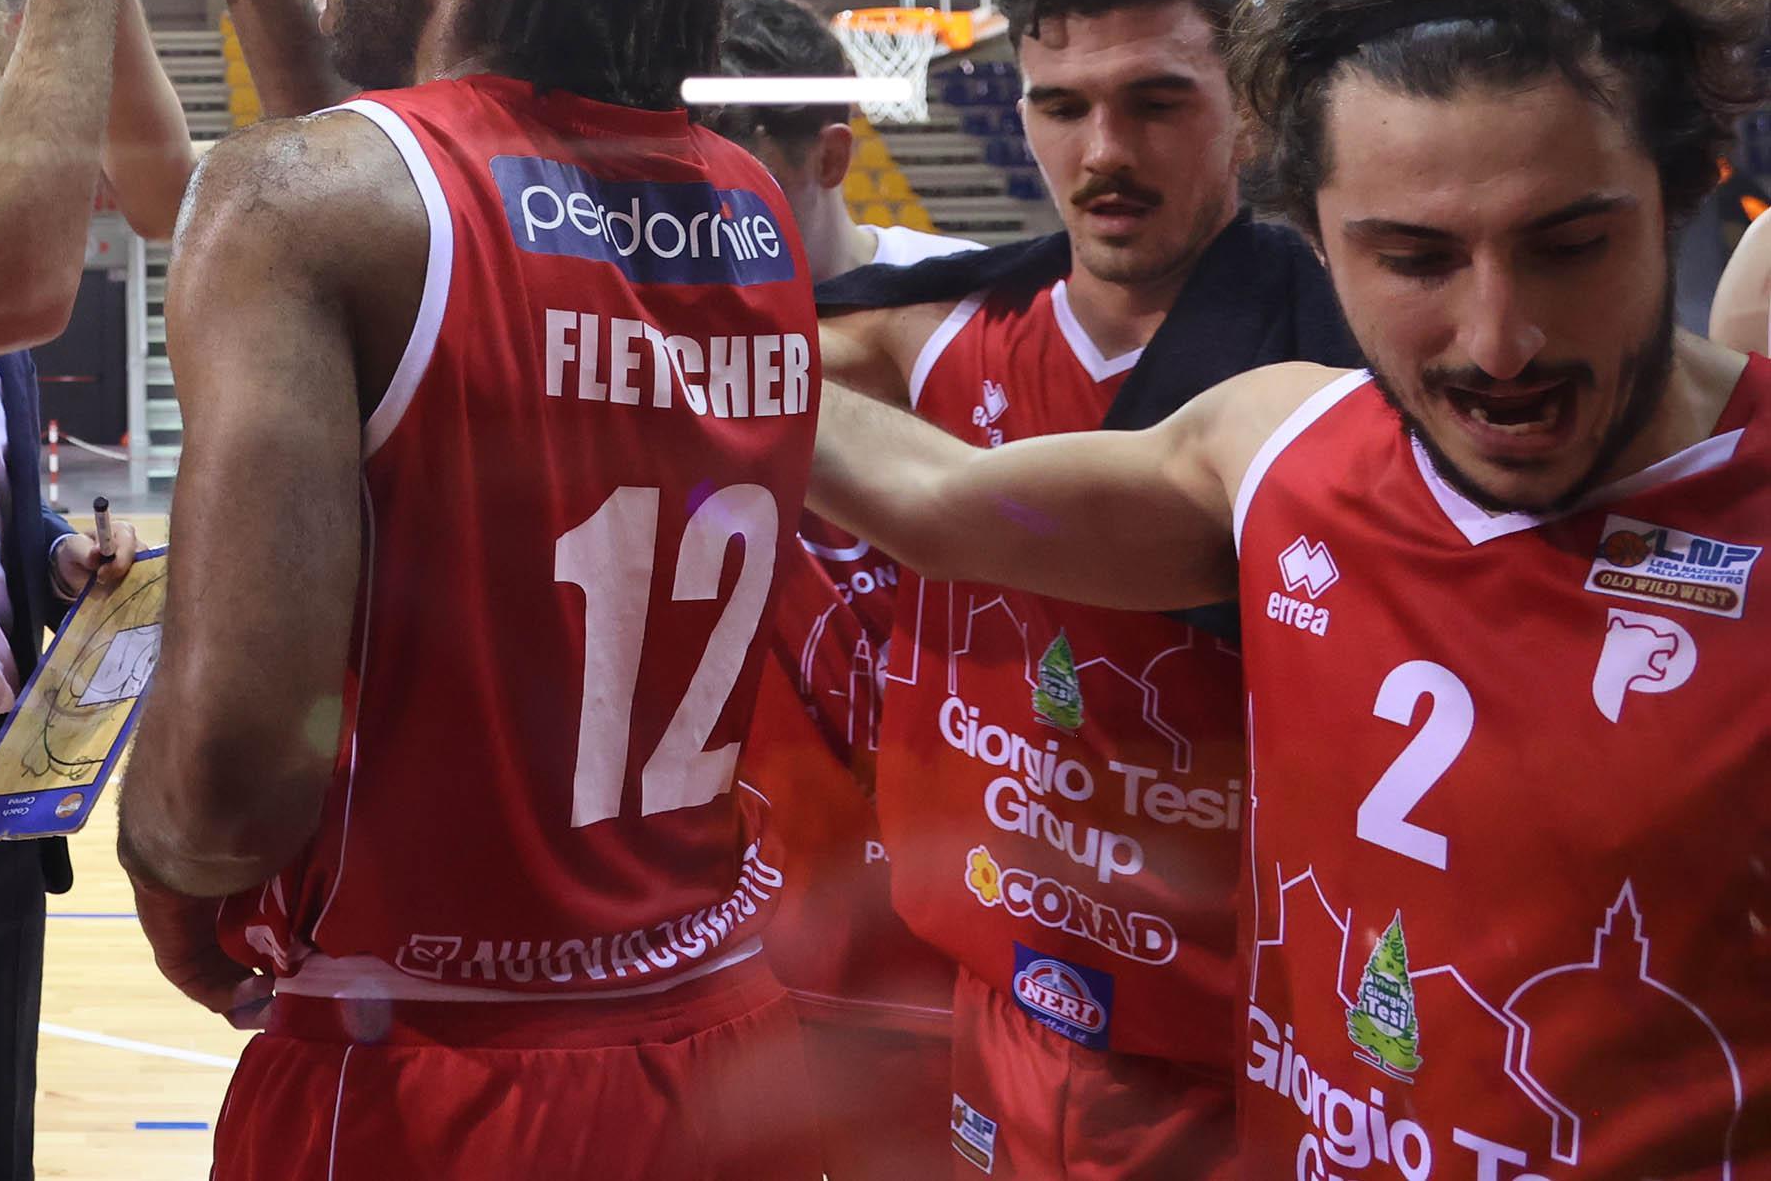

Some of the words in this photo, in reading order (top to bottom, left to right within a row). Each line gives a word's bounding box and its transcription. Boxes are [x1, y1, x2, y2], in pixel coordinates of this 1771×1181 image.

[545, 308, 810, 419] FLETCHER
[1600, 573, 1633, 589] OLD
[1635, 580, 1678, 596] WILD
[1680, 585, 1730, 606] WEST
[1650, 559, 1679, 572] LEGA
[1653, 529, 1757, 569] LNP
[554, 482, 779, 828] 12
[938, 696, 1095, 802] Giorgio
[1108, 759, 1242, 831] Tesi
[1356, 659, 1476, 872] 2
[984, 775, 1145, 883] Group
[999, 866, 1179, 965] CONAD
[1021, 978, 1096, 1025] NERI
[1364, 994, 1407, 1030] Tesi
[1365, 984, 1408, 1011] Giorgio
[1246, 1003, 1433, 1181] Giorgio
